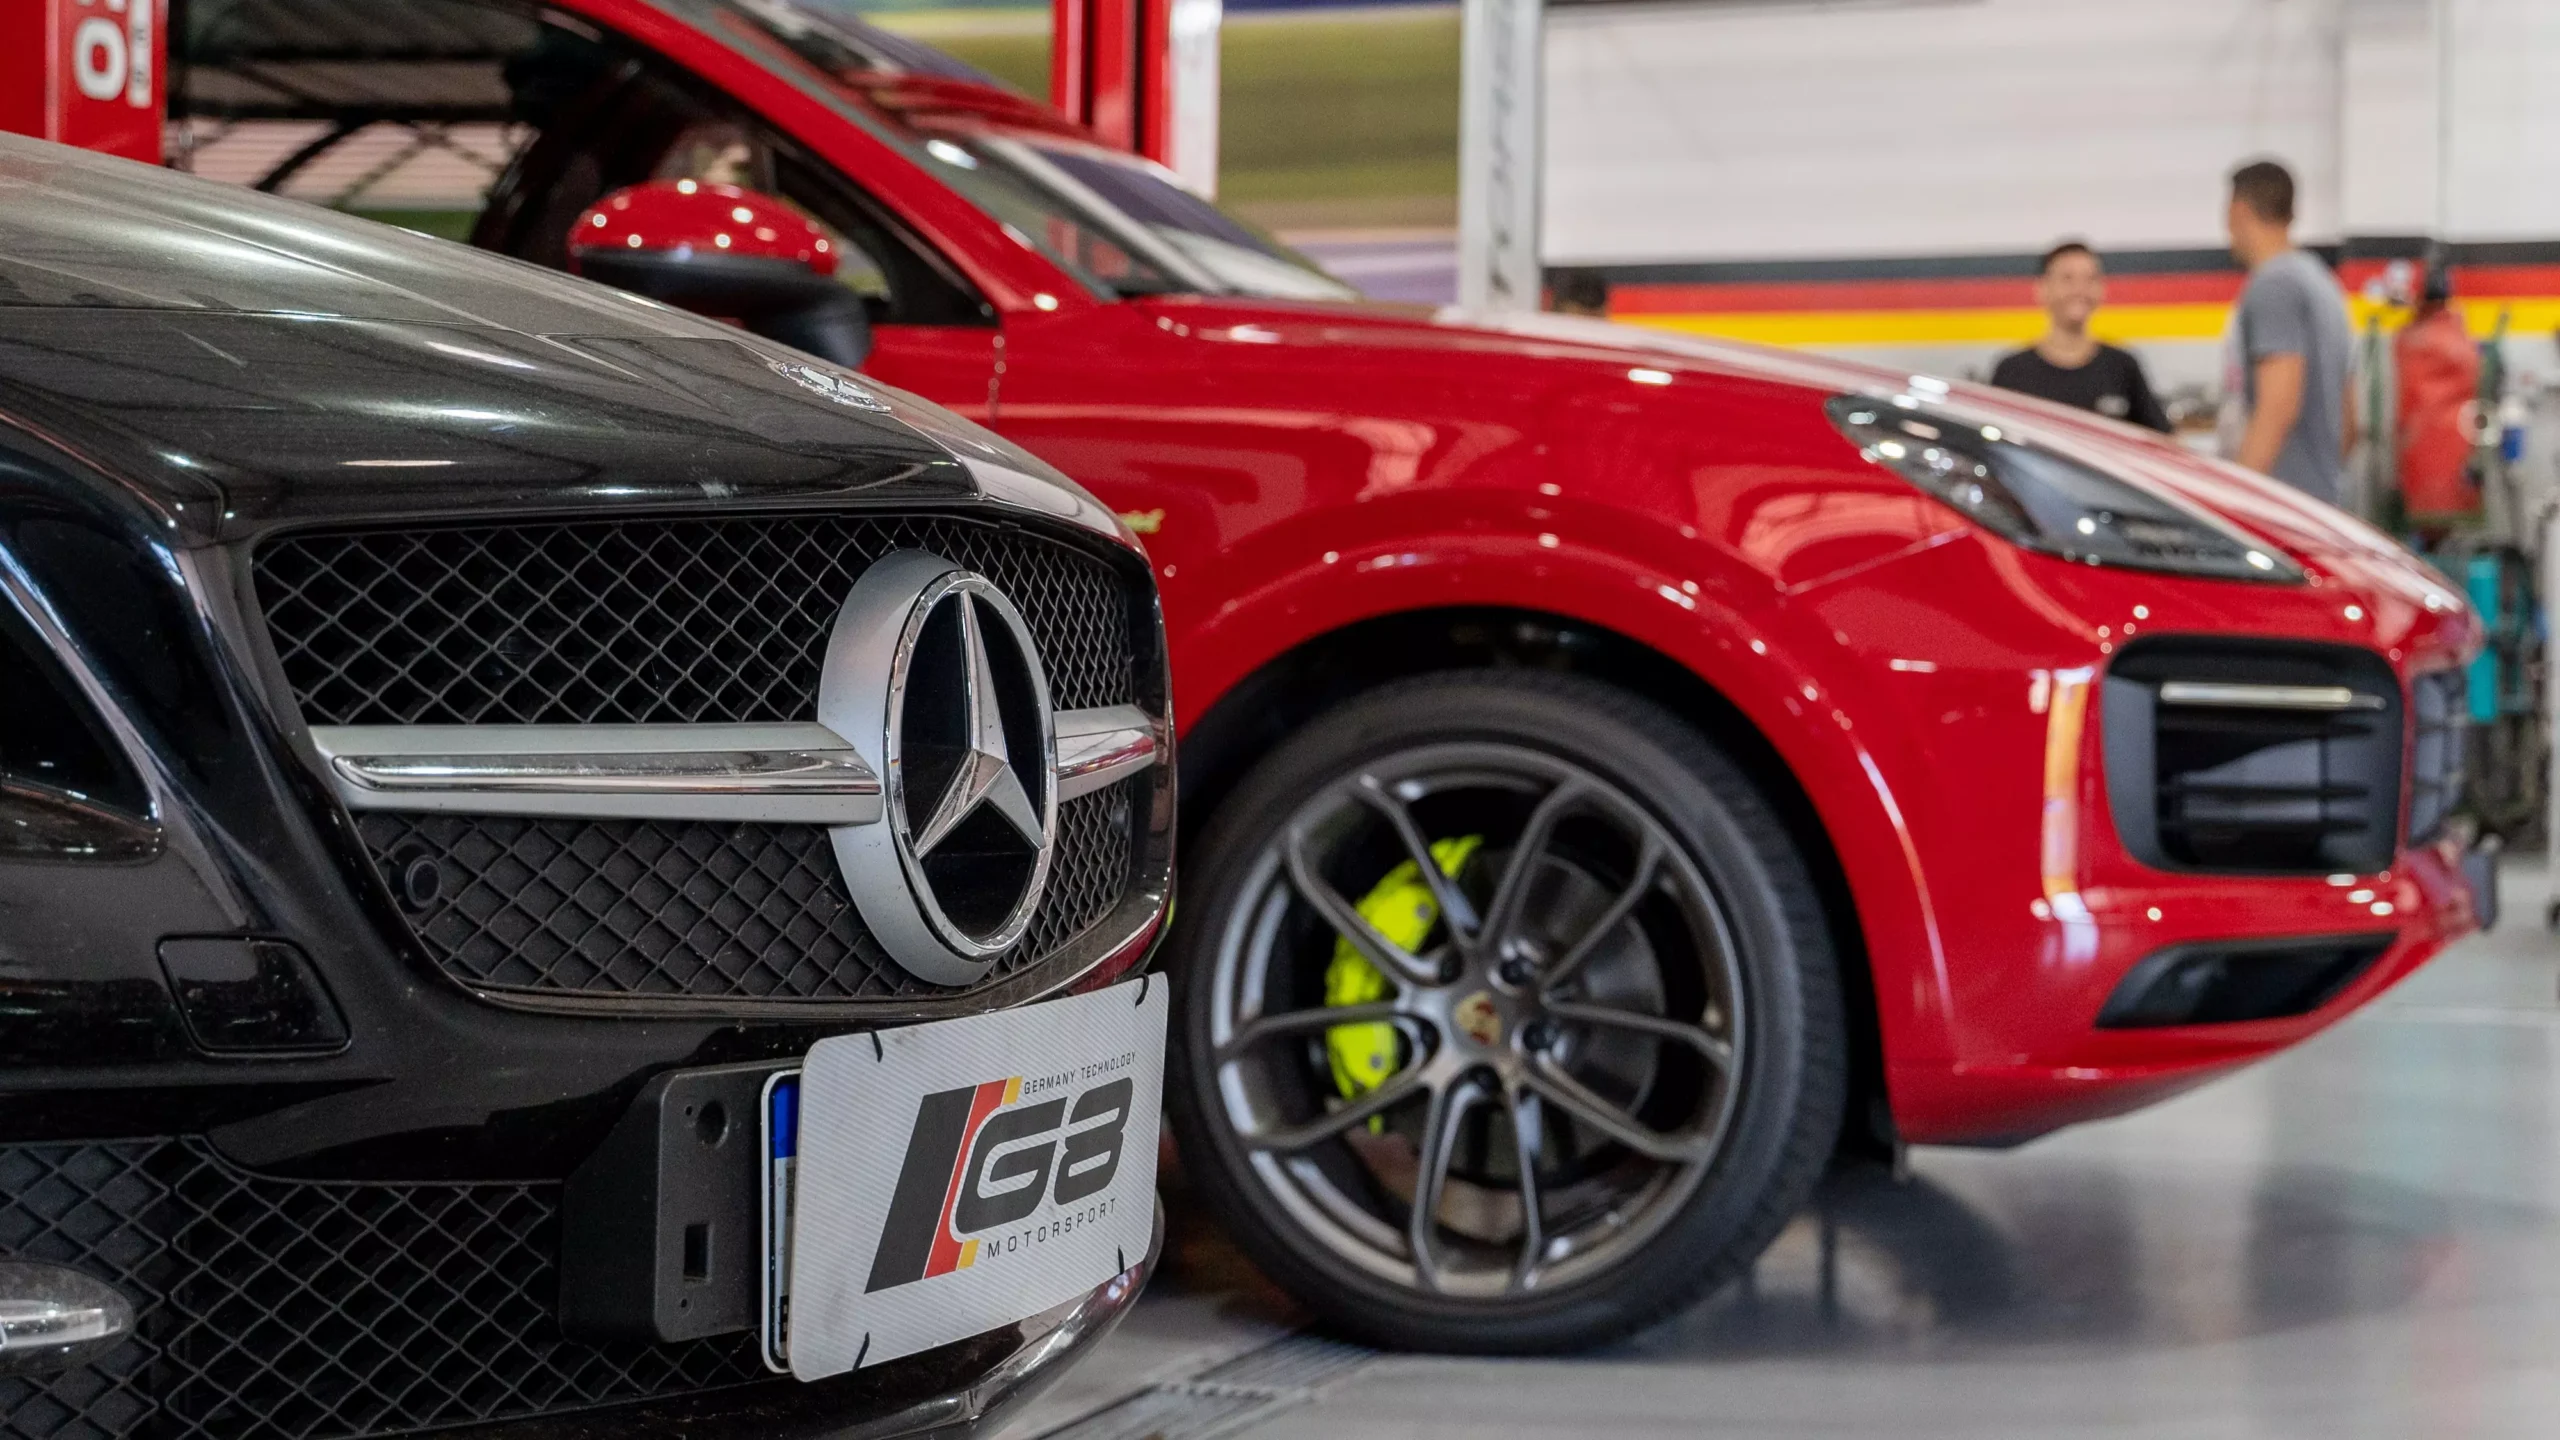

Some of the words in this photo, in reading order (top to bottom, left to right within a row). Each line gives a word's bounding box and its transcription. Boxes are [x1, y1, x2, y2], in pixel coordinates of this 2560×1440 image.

[1024, 1070, 1076, 1095] GERMANY
[1081, 1051, 1136, 1080] TECHNOLOGY
[955, 1077, 1133, 1234] G8
[987, 1198, 1116, 1259] MOTORSPORT
